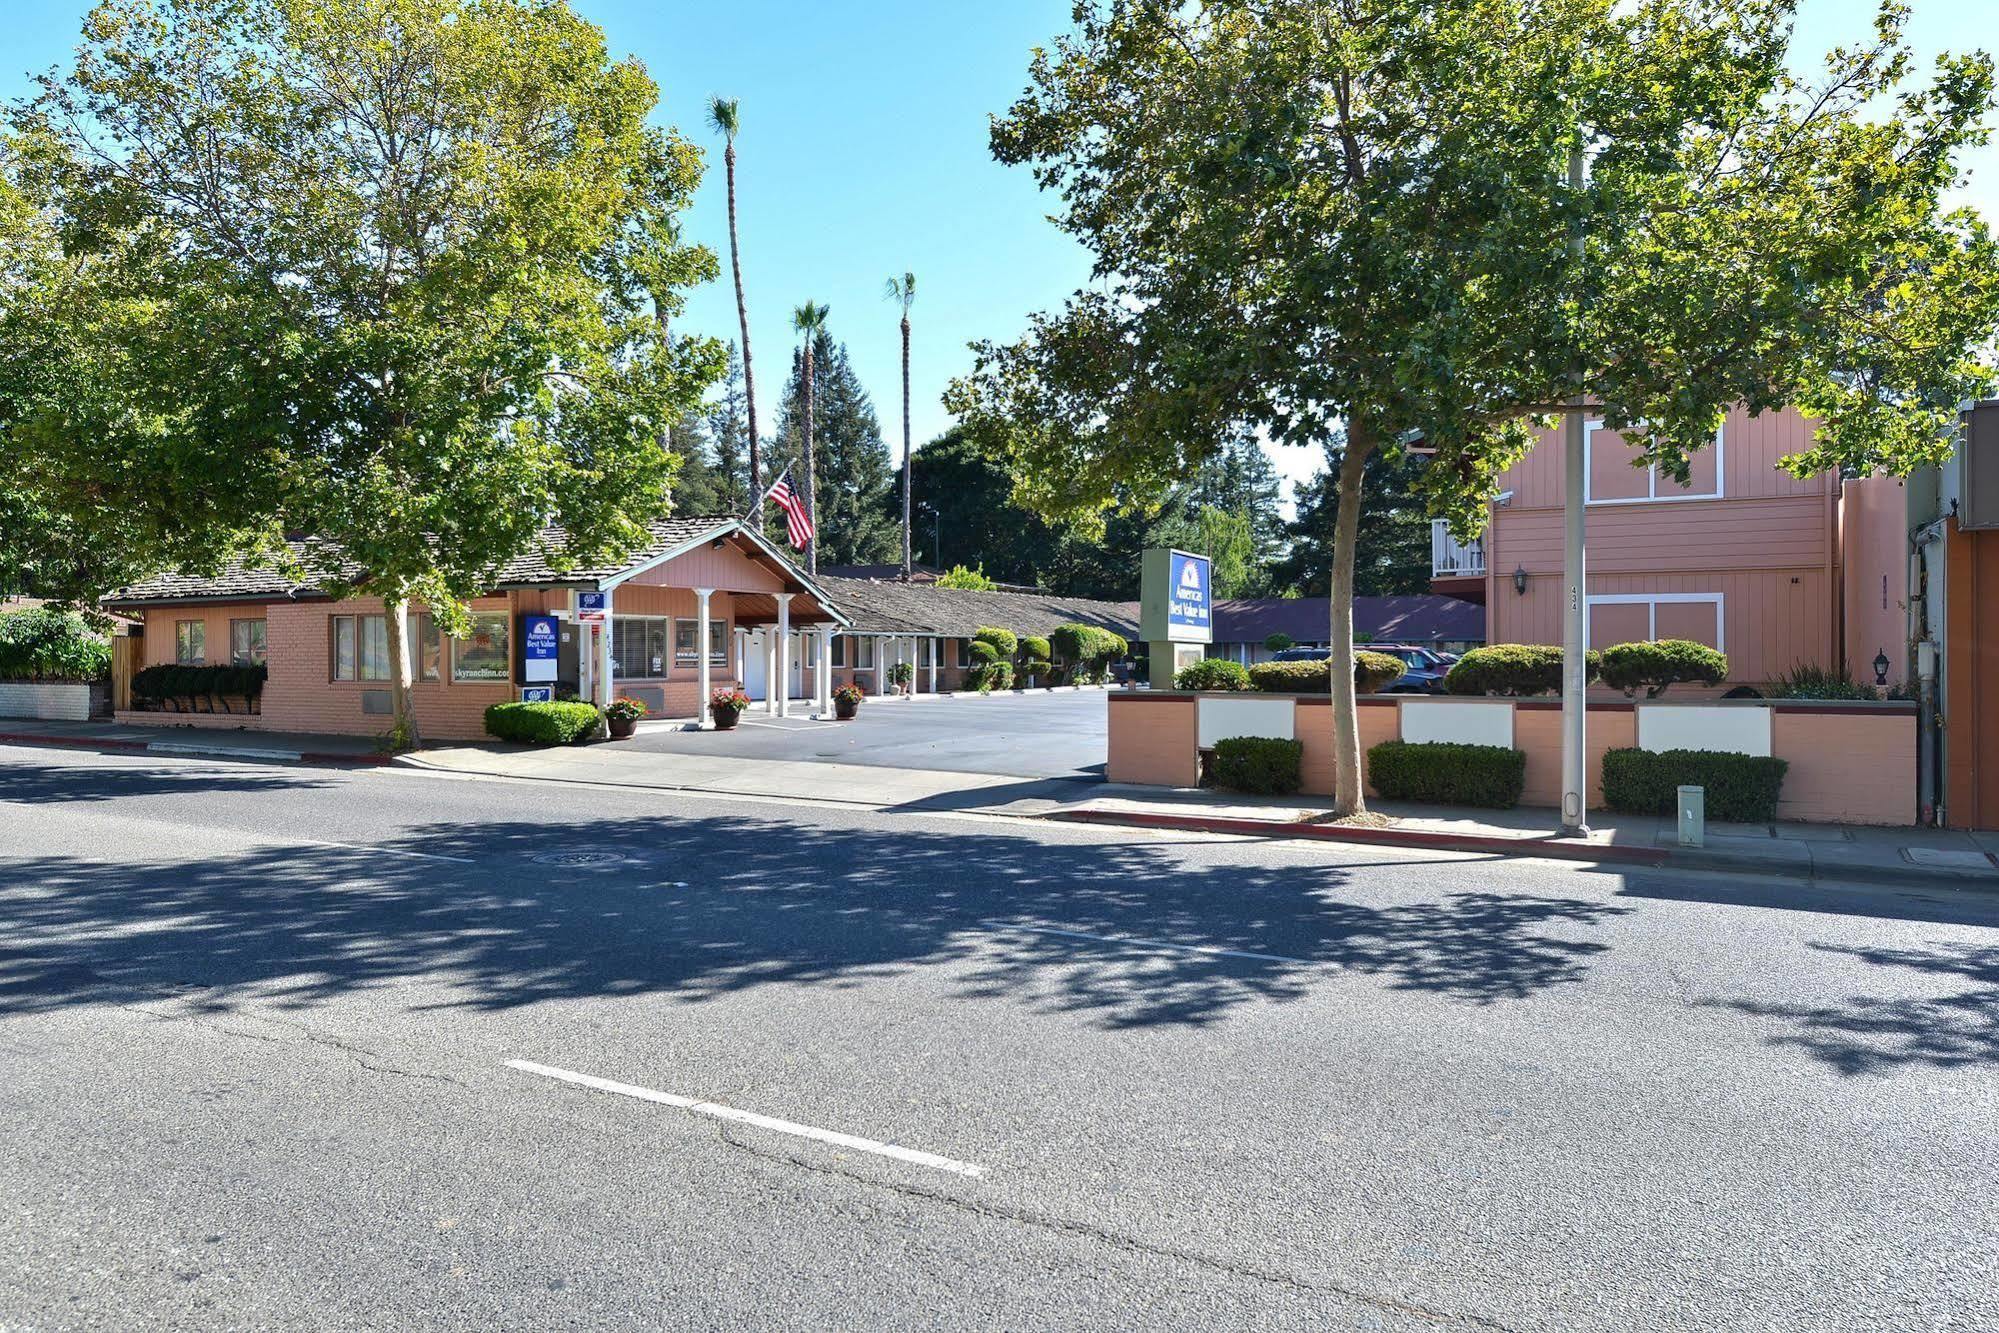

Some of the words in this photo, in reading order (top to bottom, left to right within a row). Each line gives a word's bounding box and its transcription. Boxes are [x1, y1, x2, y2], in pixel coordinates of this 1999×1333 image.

[1176, 584, 1203, 602] Americas
[1170, 600, 1183, 616] Best
[1183, 602, 1198, 618] Value
[528, 632, 555, 640] Americas
[541, 640, 556, 648] Value
